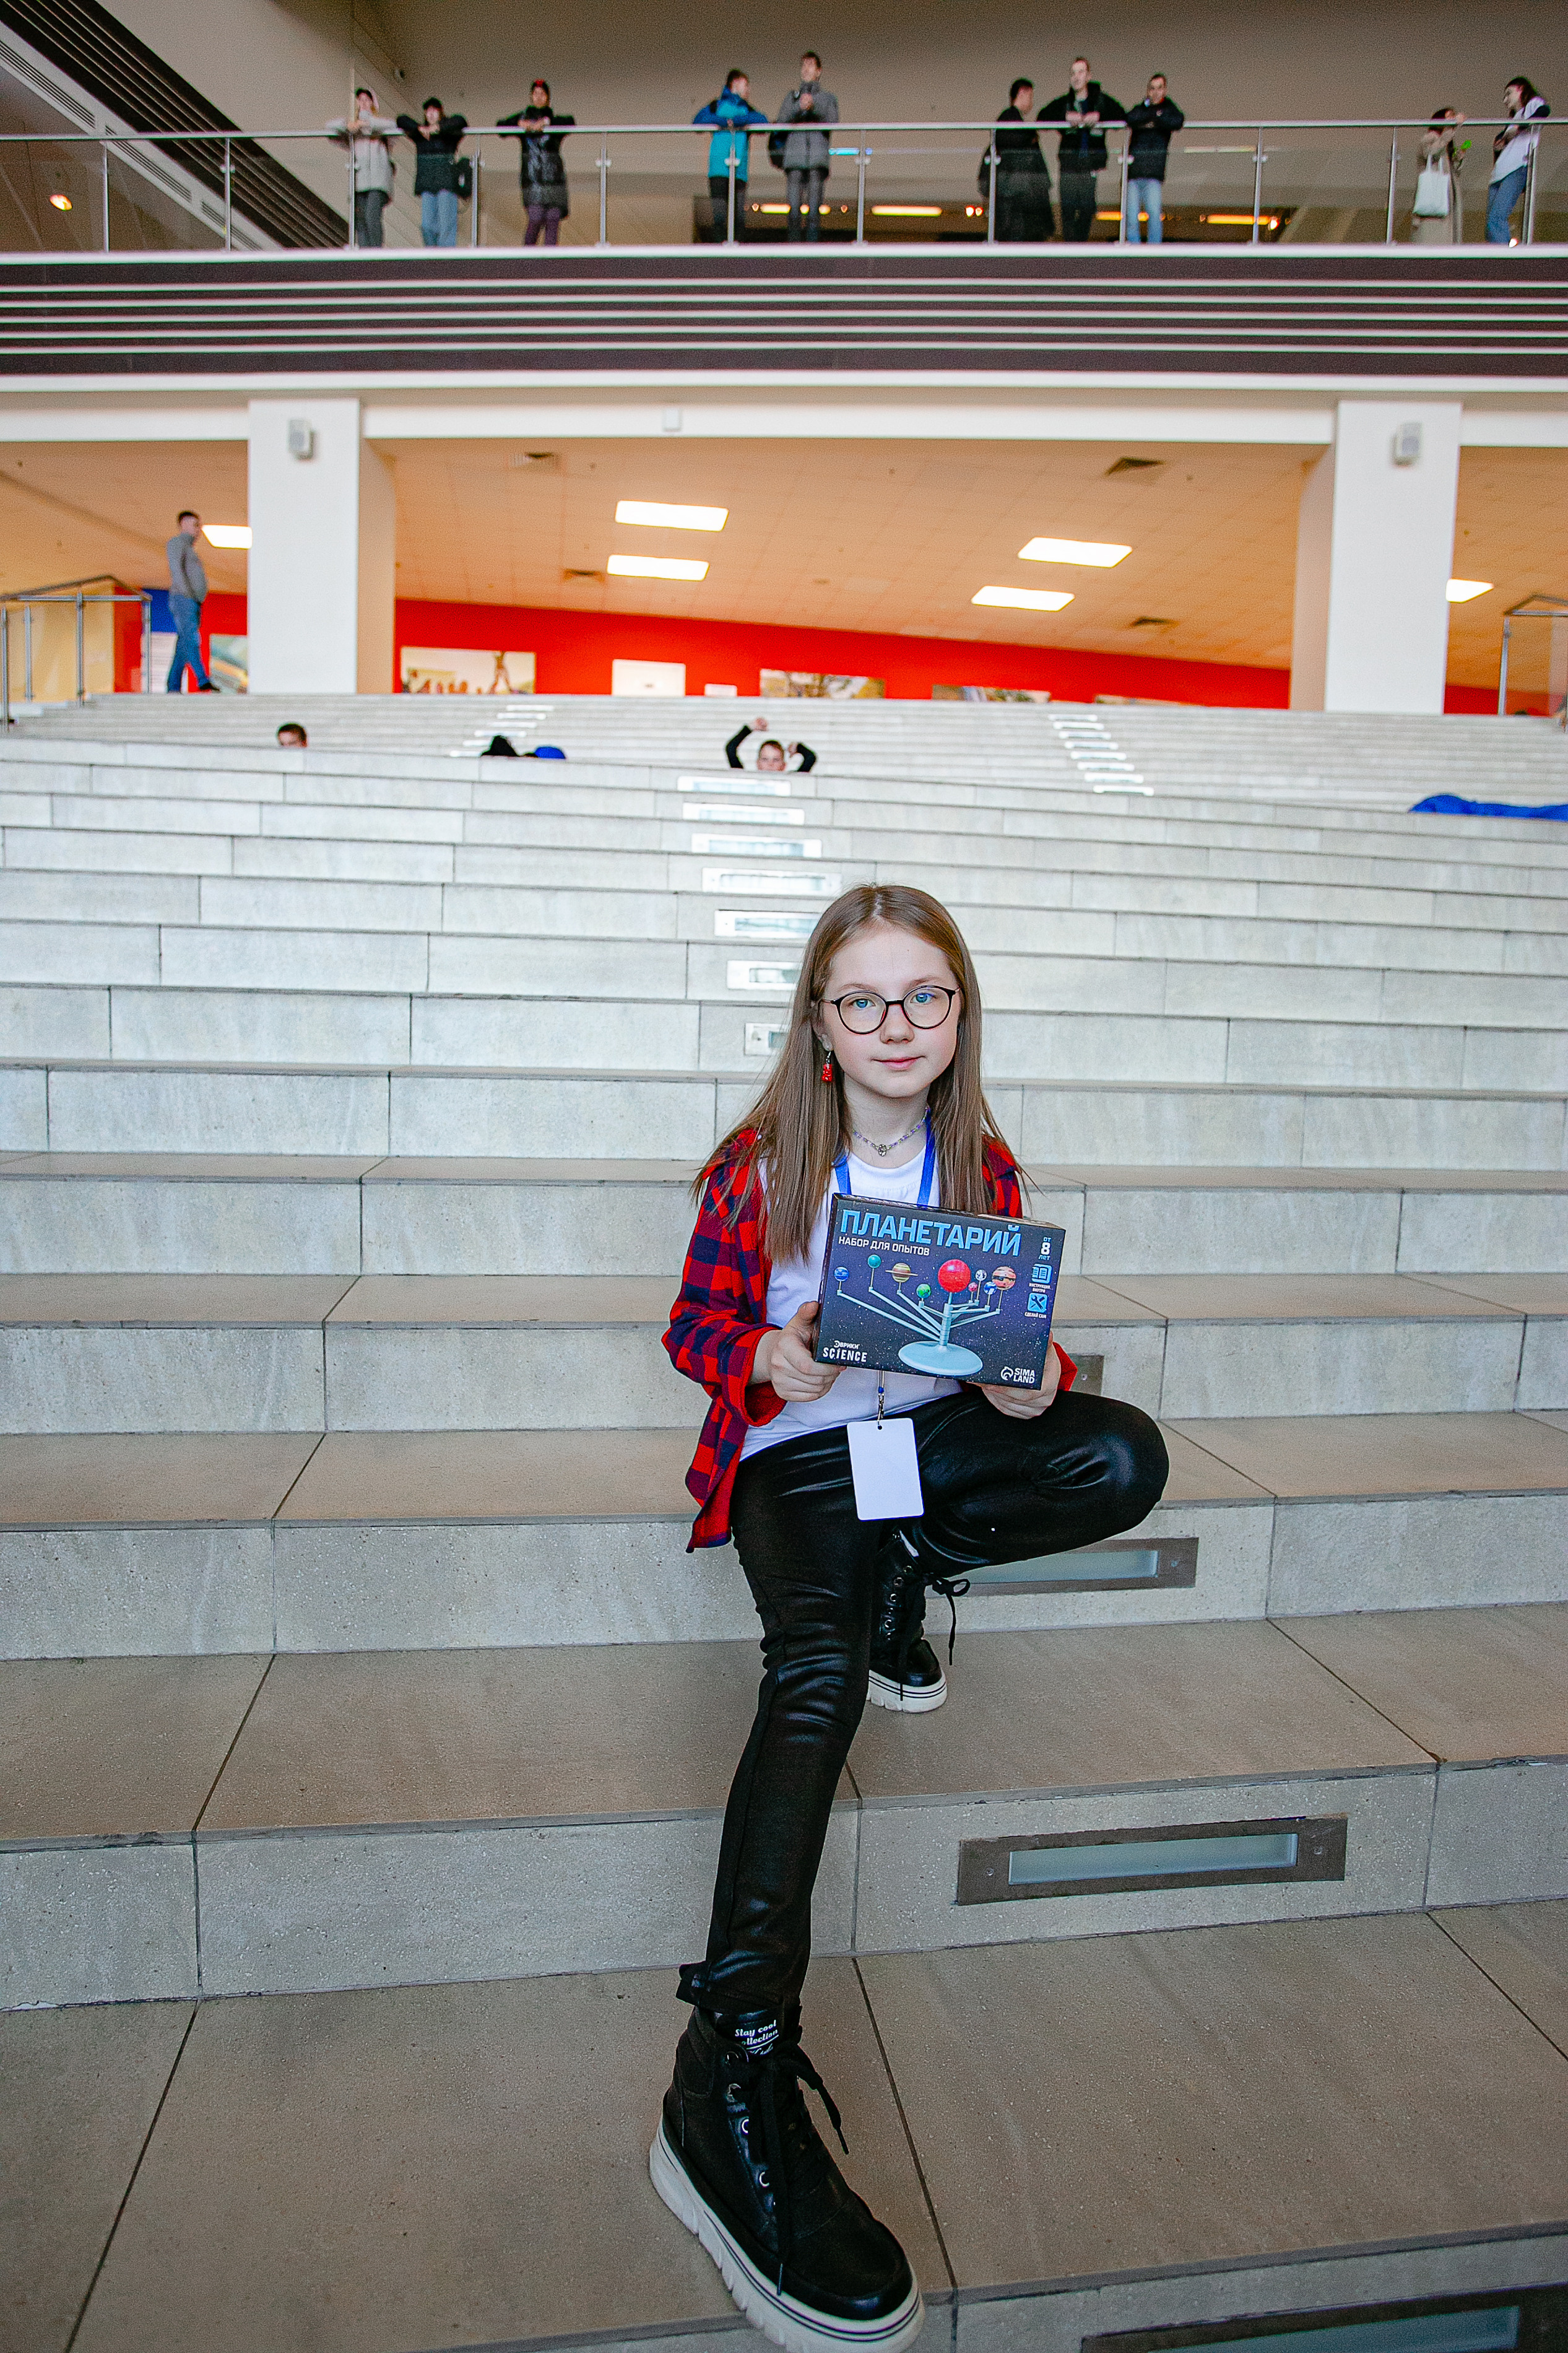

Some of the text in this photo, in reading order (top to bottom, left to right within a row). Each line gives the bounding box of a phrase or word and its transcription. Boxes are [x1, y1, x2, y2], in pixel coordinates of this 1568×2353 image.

[841, 1209, 1021, 1256] ПЛАНЕТАРИЙ
[838, 1236, 930, 1256] НАБОР ДЛЯ ОПЫТОВ
[1041, 1242, 1050, 1255] 8
[1013, 1375, 1036, 1384] LAND
[1014, 1367, 1036, 1378] SIMA
[735, 2019, 776, 2037] Stay cool
[741, 2029, 778, 2045] ollection
